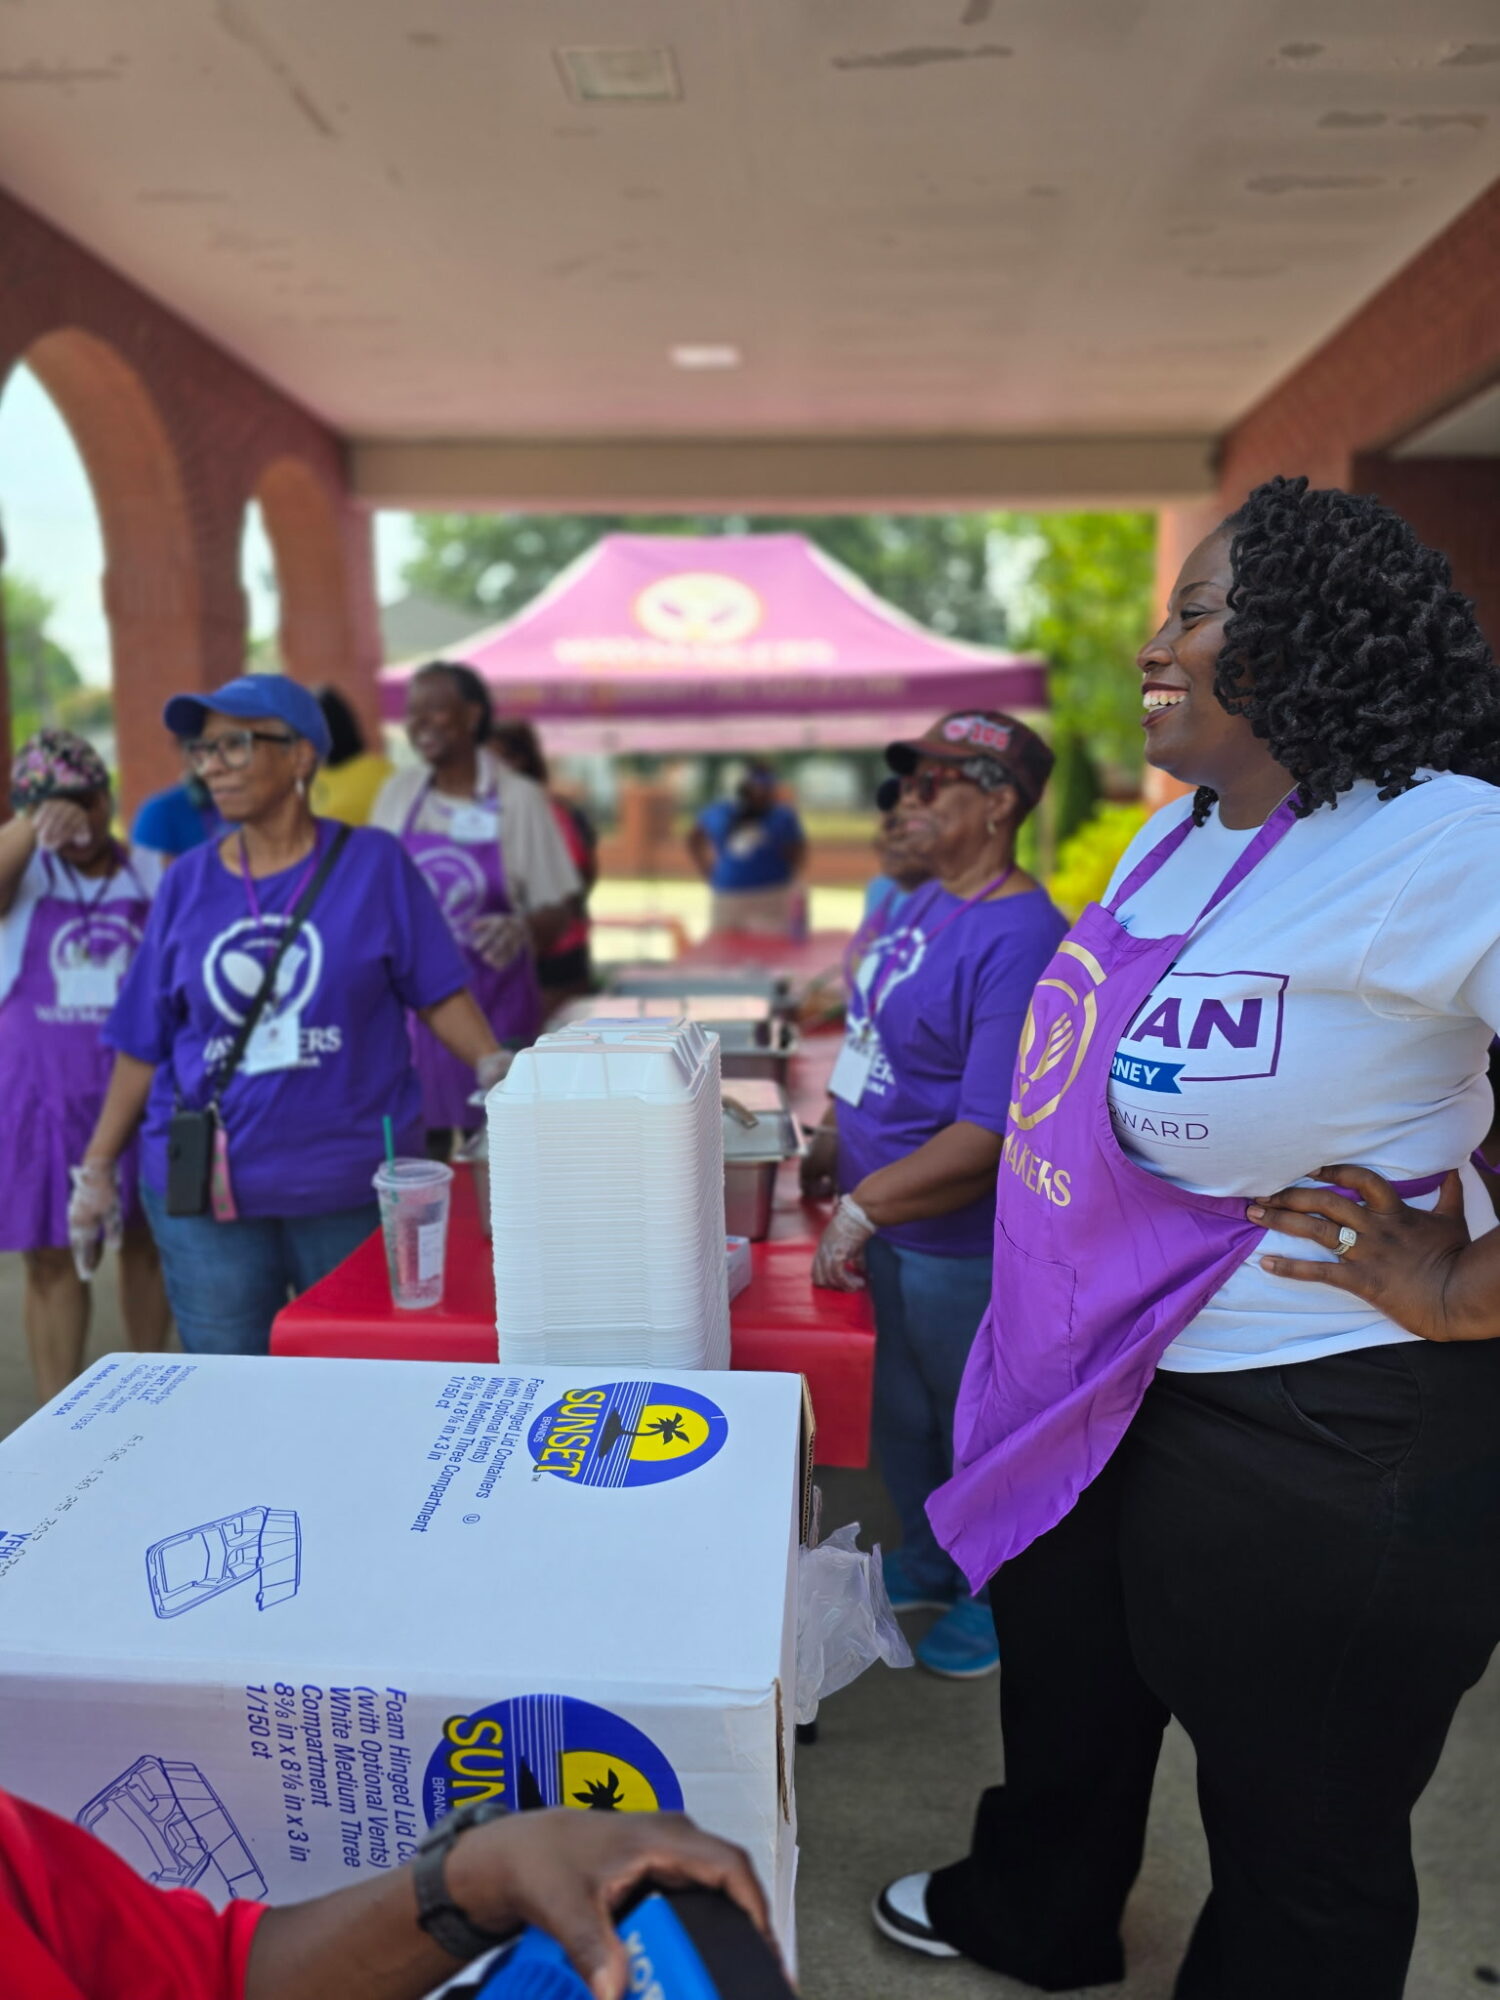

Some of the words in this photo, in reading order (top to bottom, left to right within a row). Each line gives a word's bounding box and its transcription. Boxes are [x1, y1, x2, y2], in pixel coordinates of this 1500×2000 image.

[1122, 994, 1263, 1050] AN
[441, 1376, 466, 1399] 1/150
[461, 1391, 478, 1400] in
[481, 1377, 506, 1400] White
[503, 1377, 524, 1398] (with
[523, 1377, 544, 1400] Foam
[52, 1401, 77, 1416] USA
[435, 1399, 450, 1409] ct
[463, 1401, 491, 1435] Medium
[485, 1399, 514, 1434] Optional
[508, 1401, 534, 1433] Hinged
[442, 1425, 460, 1434] in
[501, 1433, 520, 1447] Lid
[533, 1389, 606, 1478] SUNSET
[534, 1416, 552, 1443] BRANDS
[427, 1451, 446, 1460] in
[449, 1437, 475, 1463] Three
[467, 1435, 498, 1464] Vents)
[475, 1448, 513, 1498] Containers
[410, 1464, 460, 1532] Compartment
[246, 1684, 270, 1737] 1/150
[330, 1687, 353, 1739] White
[353, 1686, 380, 1735] (with
[385, 1687, 407, 1740] Foam
[276, 1723, 298, 1740] in
[251, 1740, 273, 1759] ct
[278, 1743, 296, 1756] x
[300, 1684, 332, 1808] Compartment
[358, 1739, 387, 1812] Optional
[387, 1744, 414, 1807] Hinged
[442, 1715, 505, 1808] SUN
[333, 1743, 358, 1814] Medium
[284, 1794, 305, 1811] in
[286, 1814, 303, 1827] x
[394, 1810, 417, 1838] Lid
[288, 1830, 309, 1843] 3
[341, 1821, 362, 1868] Three
[367, 1816, 391, 1868] Vents)
[289, 1845, 311, 1862] in
